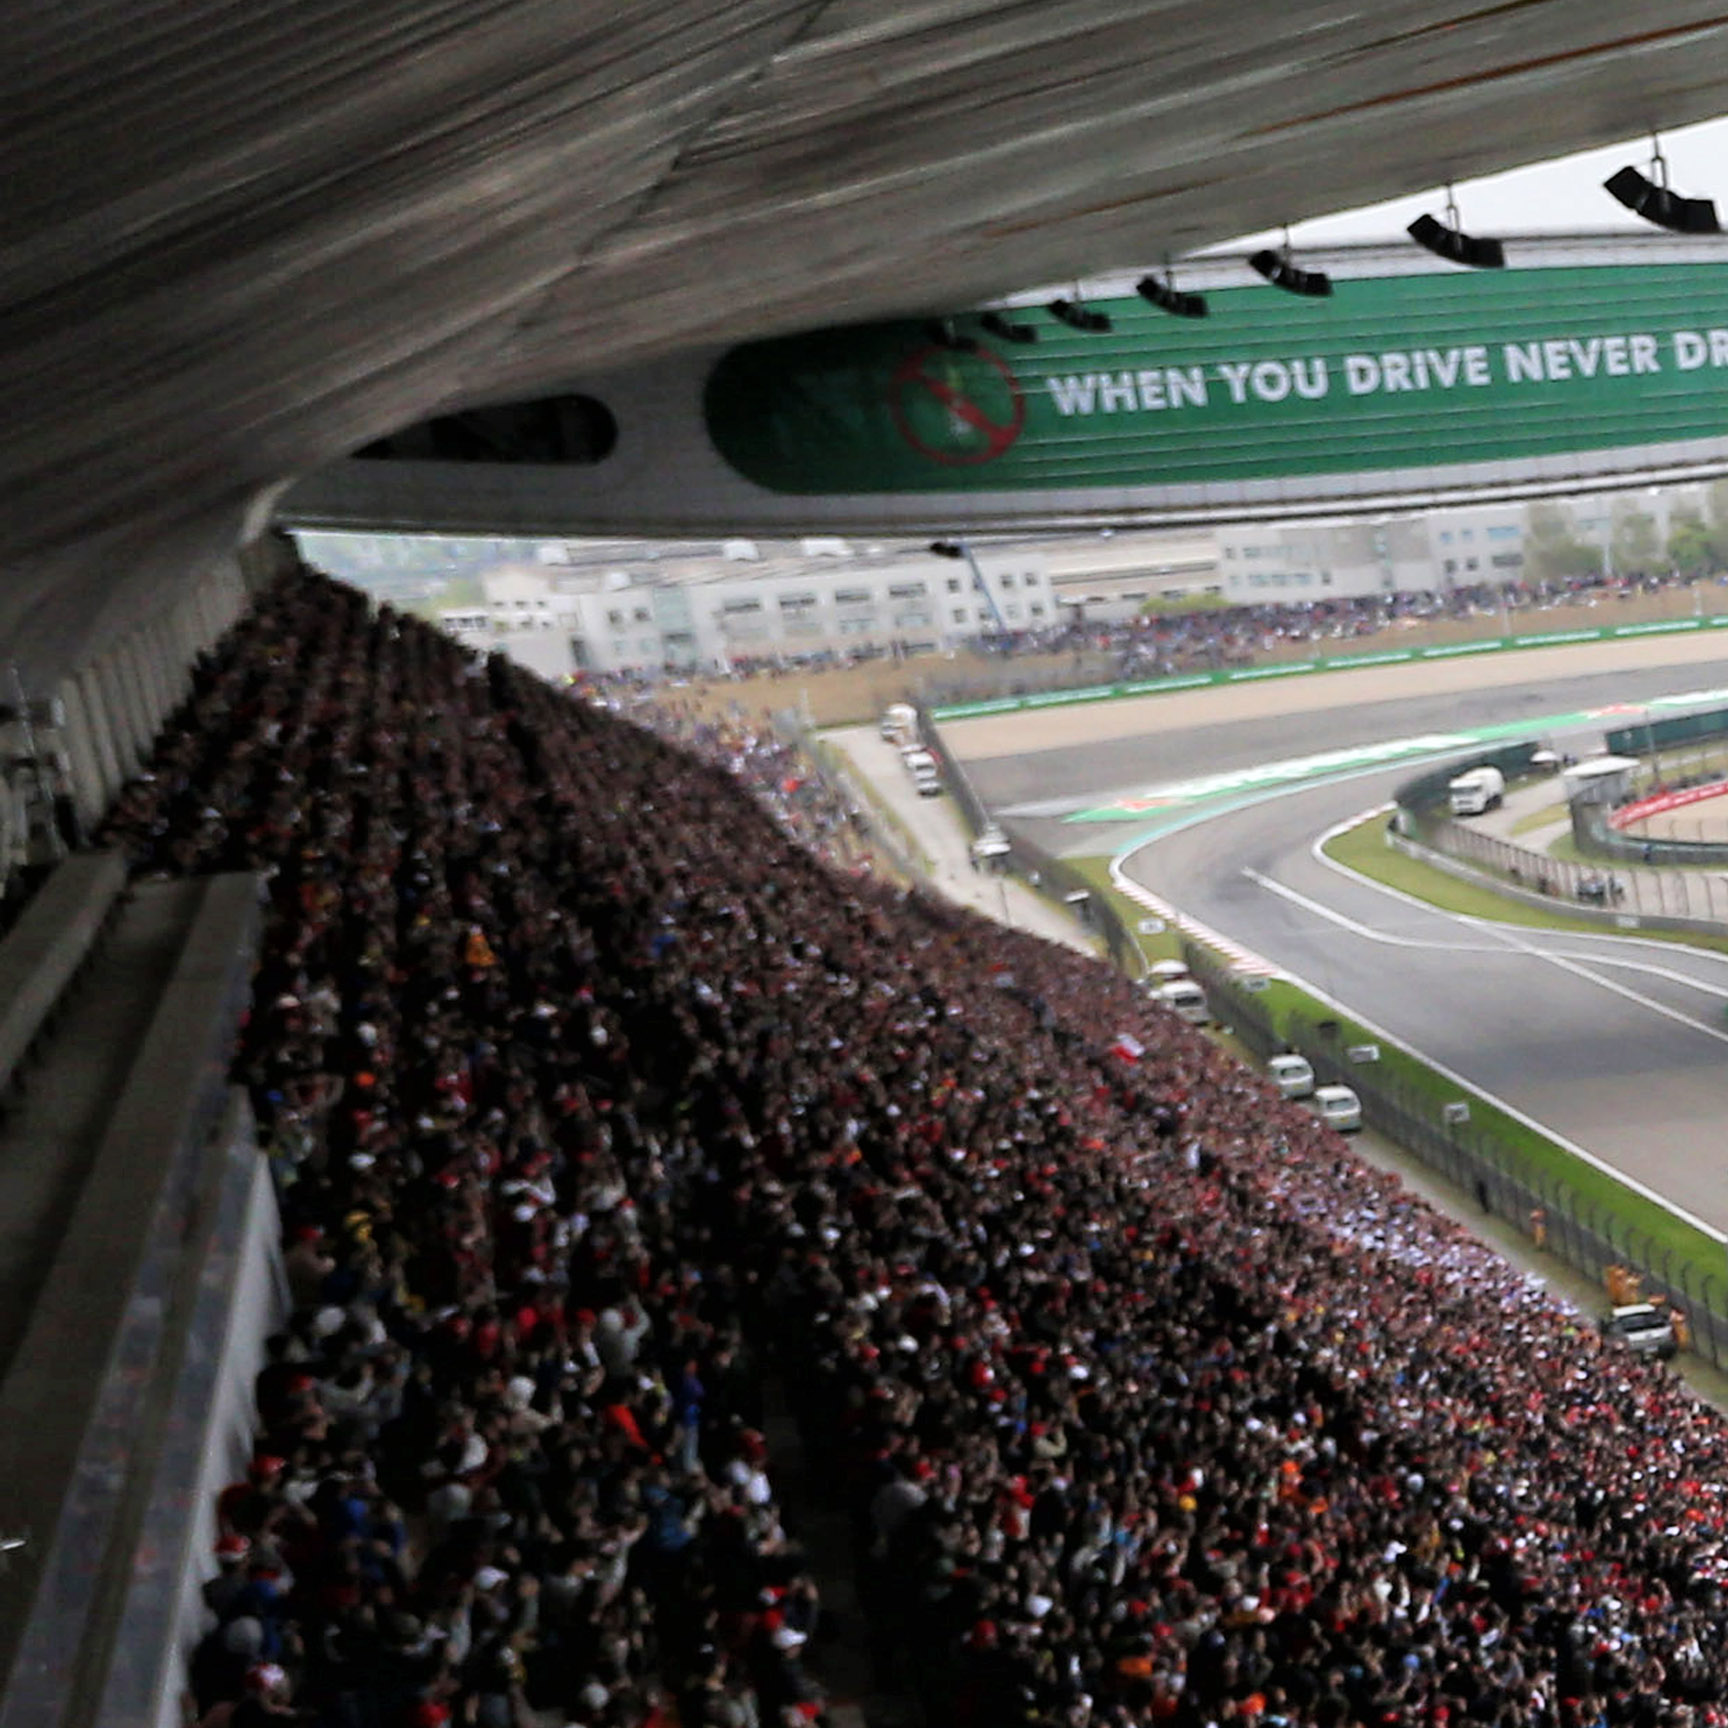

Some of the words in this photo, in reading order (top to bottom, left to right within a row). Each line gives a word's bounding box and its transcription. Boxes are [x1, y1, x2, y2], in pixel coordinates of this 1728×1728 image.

[1045, 366, 1207, 417] WHEN
[1219, 358, 1329, 402] YOU
[1343, 345, 1490, 397] DRIVE
[1503, 334, 1662, 384] NEVER
